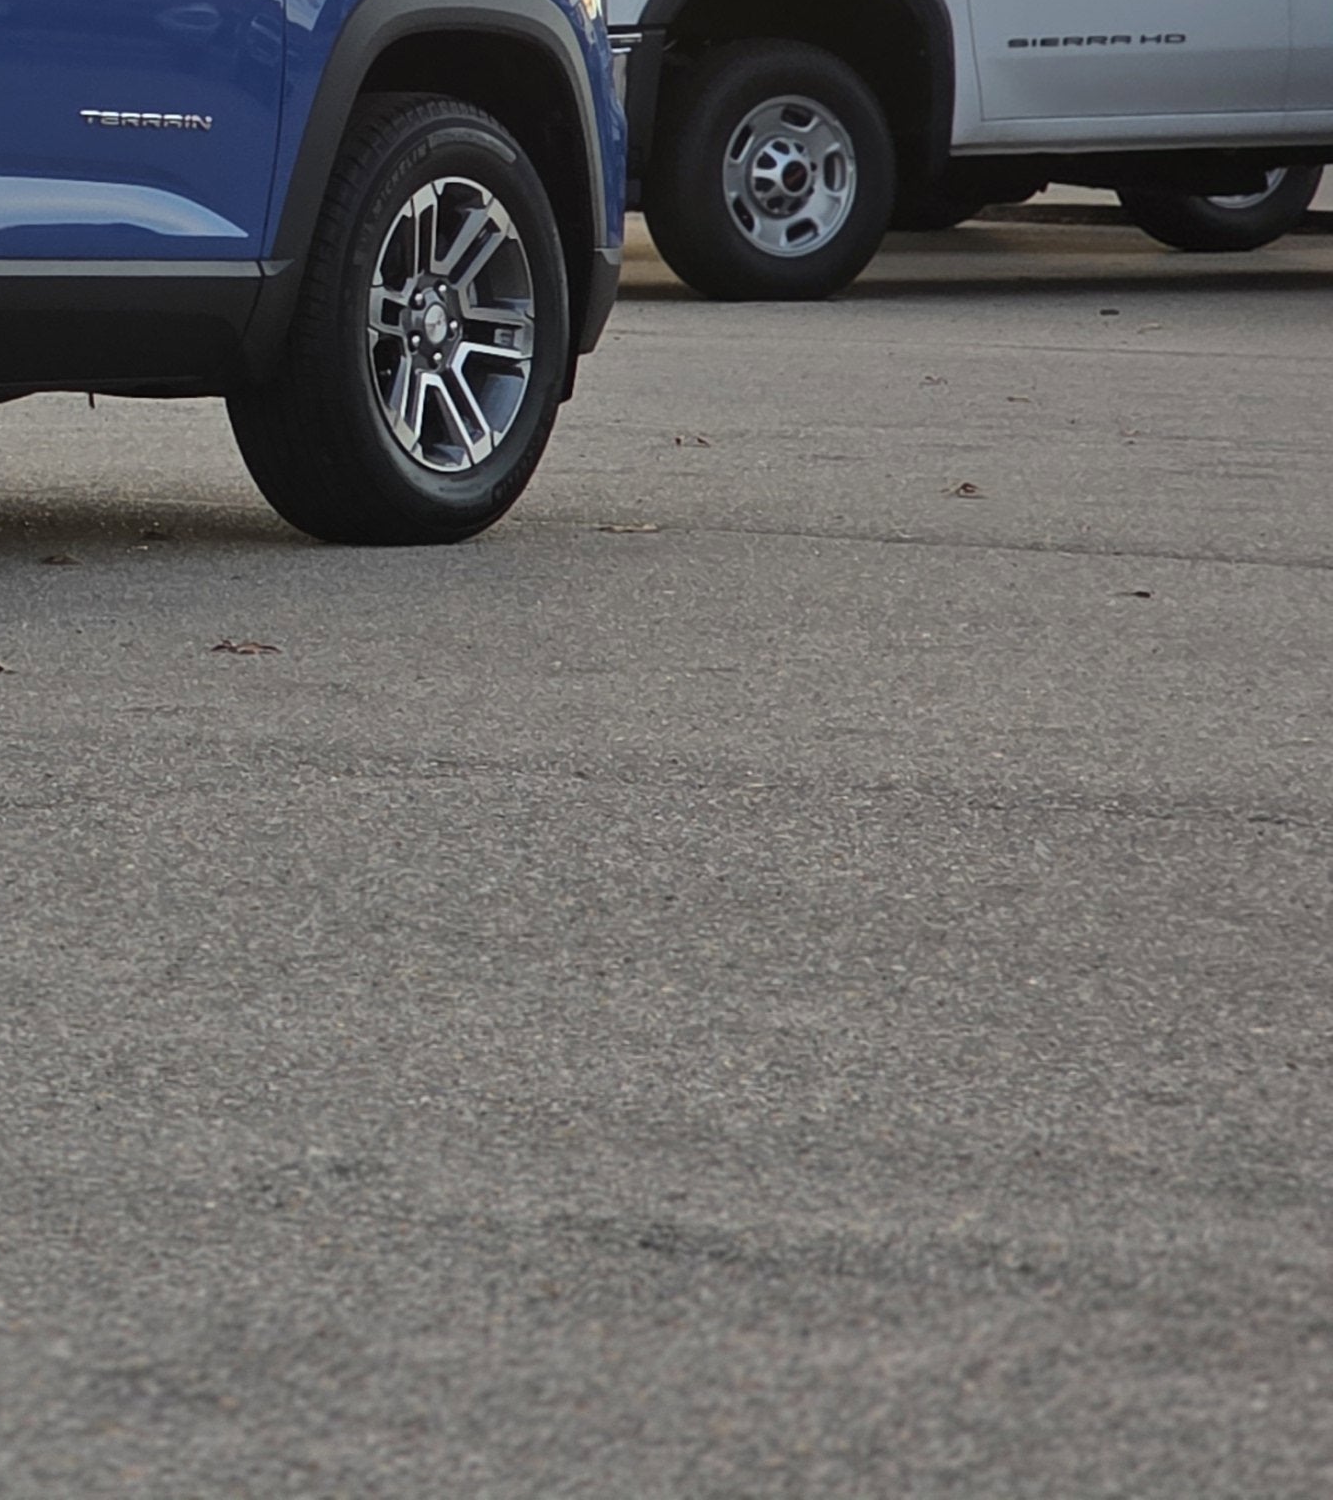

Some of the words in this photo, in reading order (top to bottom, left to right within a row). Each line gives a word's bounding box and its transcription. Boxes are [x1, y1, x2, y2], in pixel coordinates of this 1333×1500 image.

[1007, 34, 1132, 49] SIERRA
[1140, 33, 1187, 45] HD
[79, 109, 213, 130] TERRAIN
